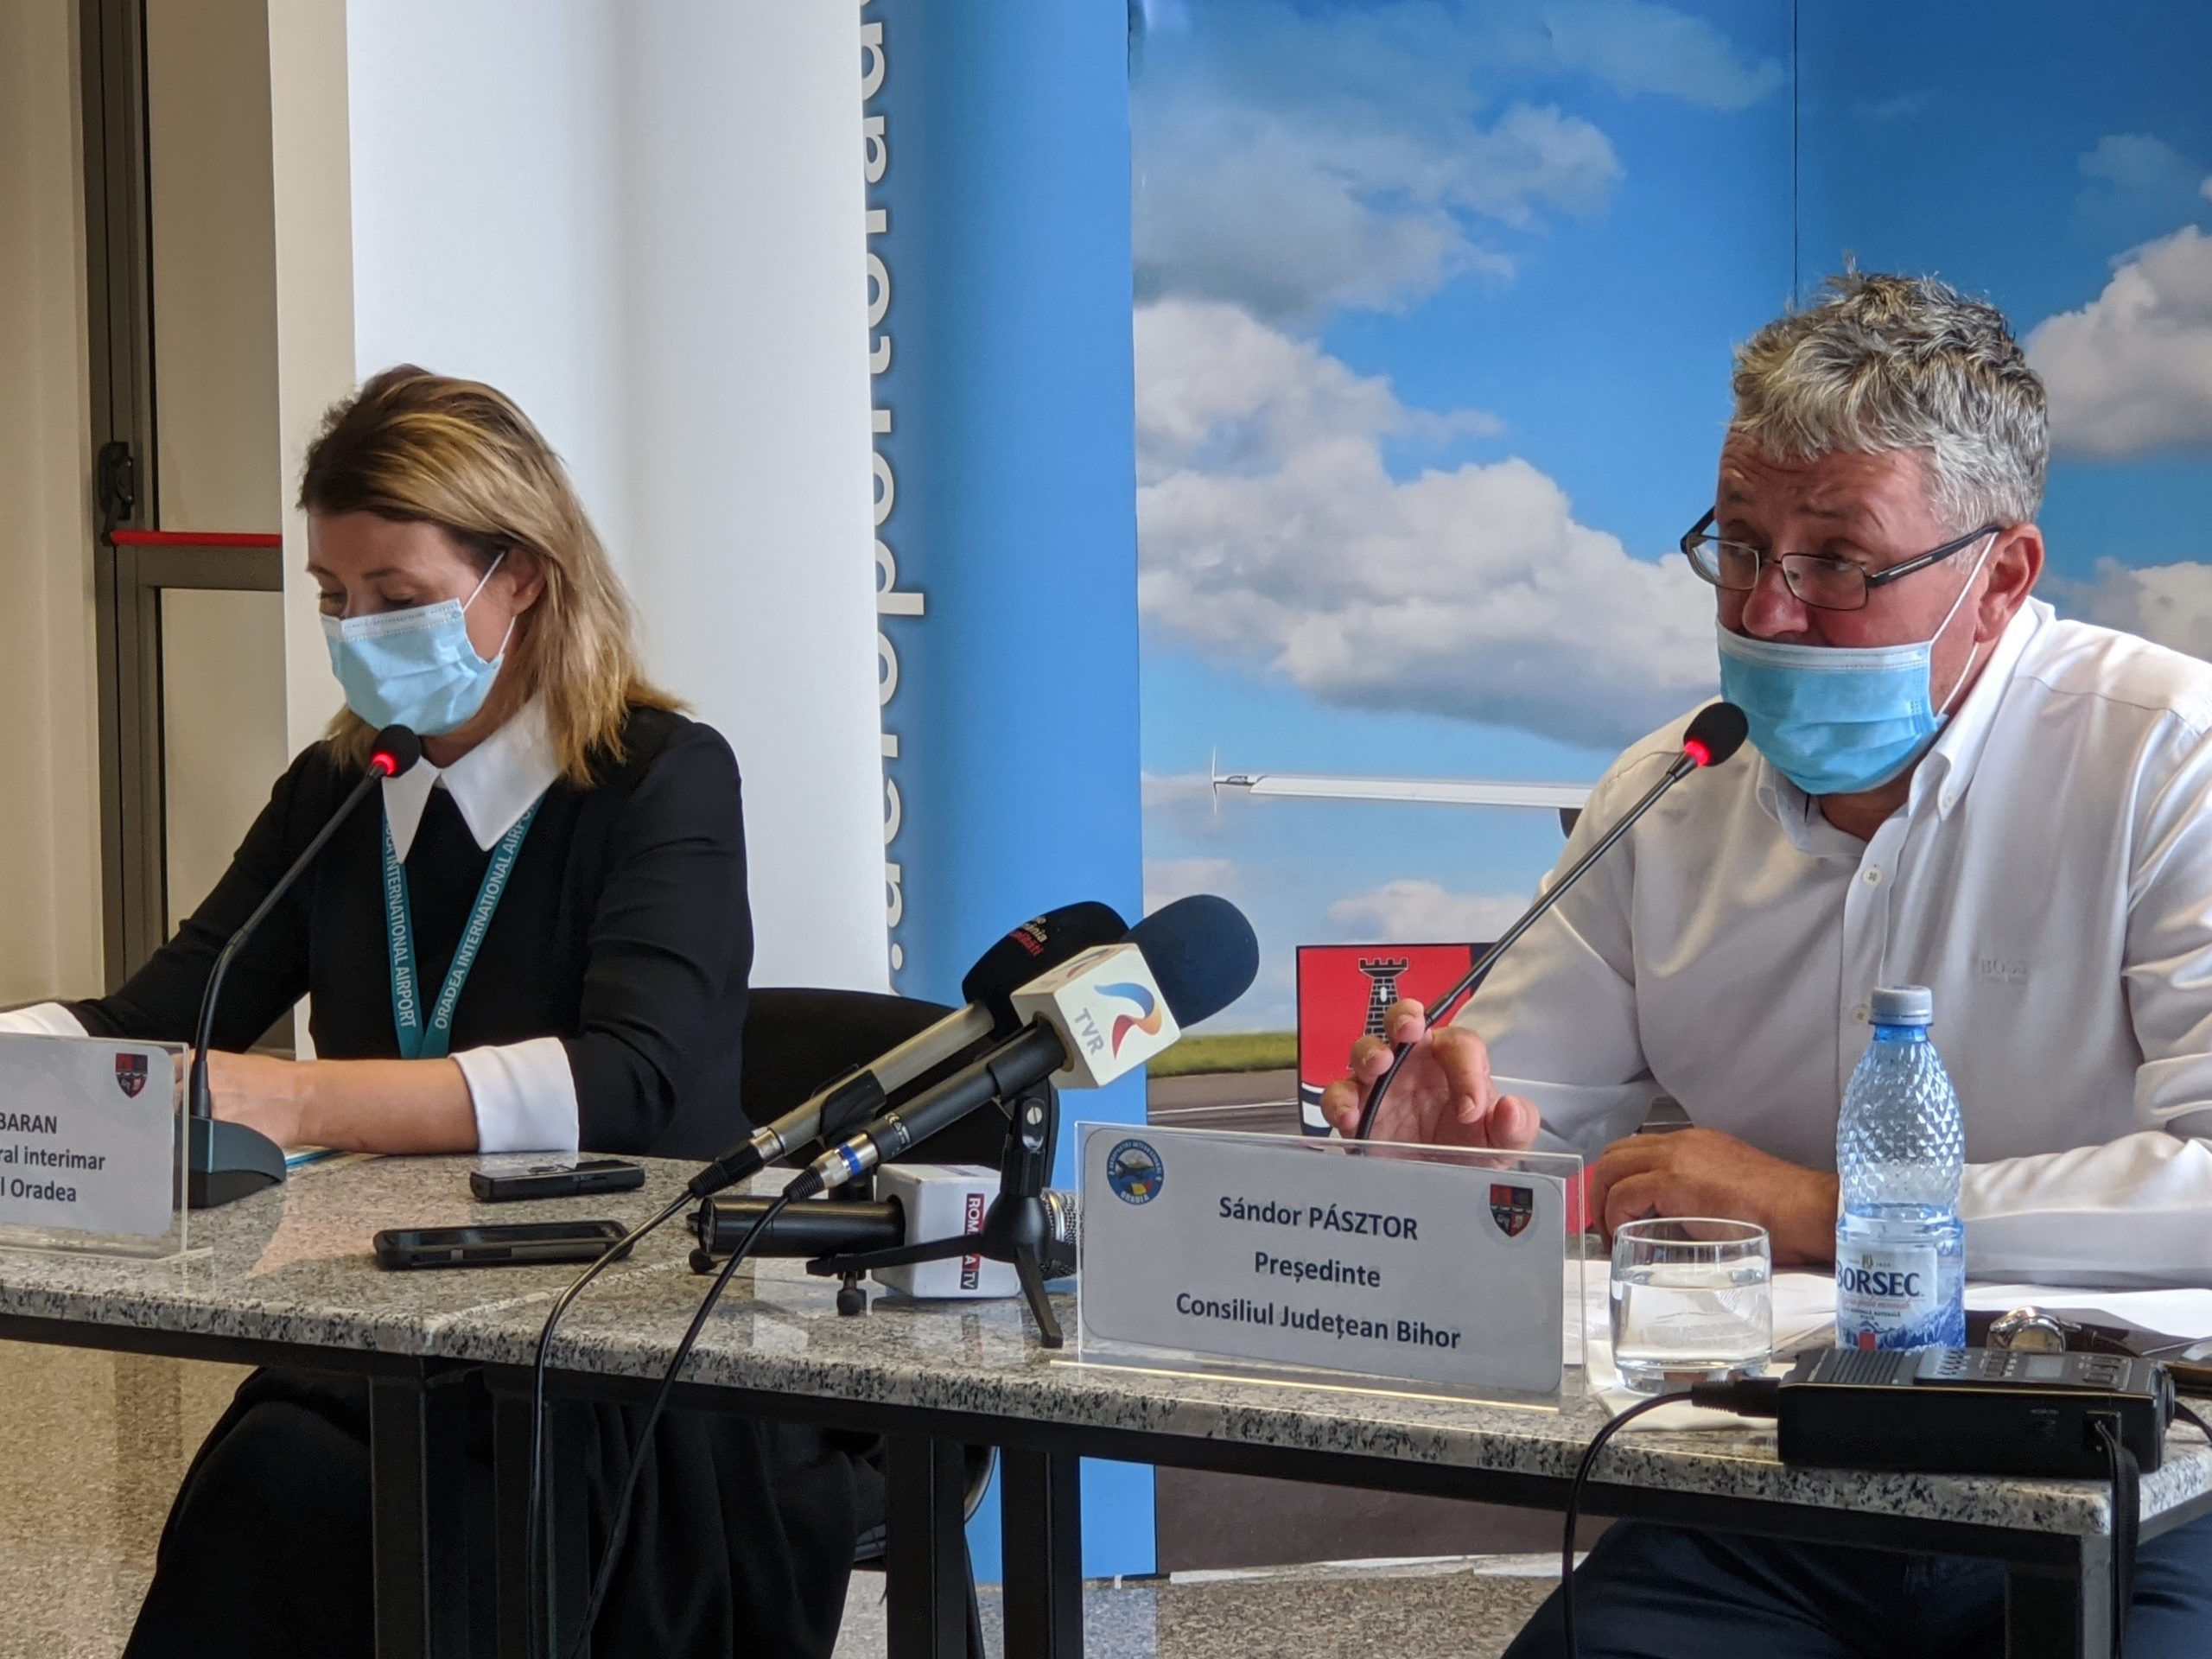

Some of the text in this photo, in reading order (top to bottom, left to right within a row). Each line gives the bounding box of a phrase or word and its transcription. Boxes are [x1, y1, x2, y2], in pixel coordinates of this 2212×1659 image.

[386, 855, 408, 965] INTERNATIONAL
[435, 969, 465, 1029] ORADEA
[457, 855, 512, 968] INTERNATIONAL
[395, 967, 416, 1027] AIRPORT
[1075, 1007, 1104, 1056] TVR
[24, 1146, 105, 1170] interimar
[10, 1179, 77, 1202] Oradea
[963, 1198, 981, 1288] ROMA TV
[1219, 1196, 1418, 1241] Sándor PÁSZTOR
[1255, 1251, 1381, 1287] Președinte
[1837, 1260, 1920, 1297] BORSEC
[1176, 1293, 1461, 1349] Consiliul Județean Bihor
